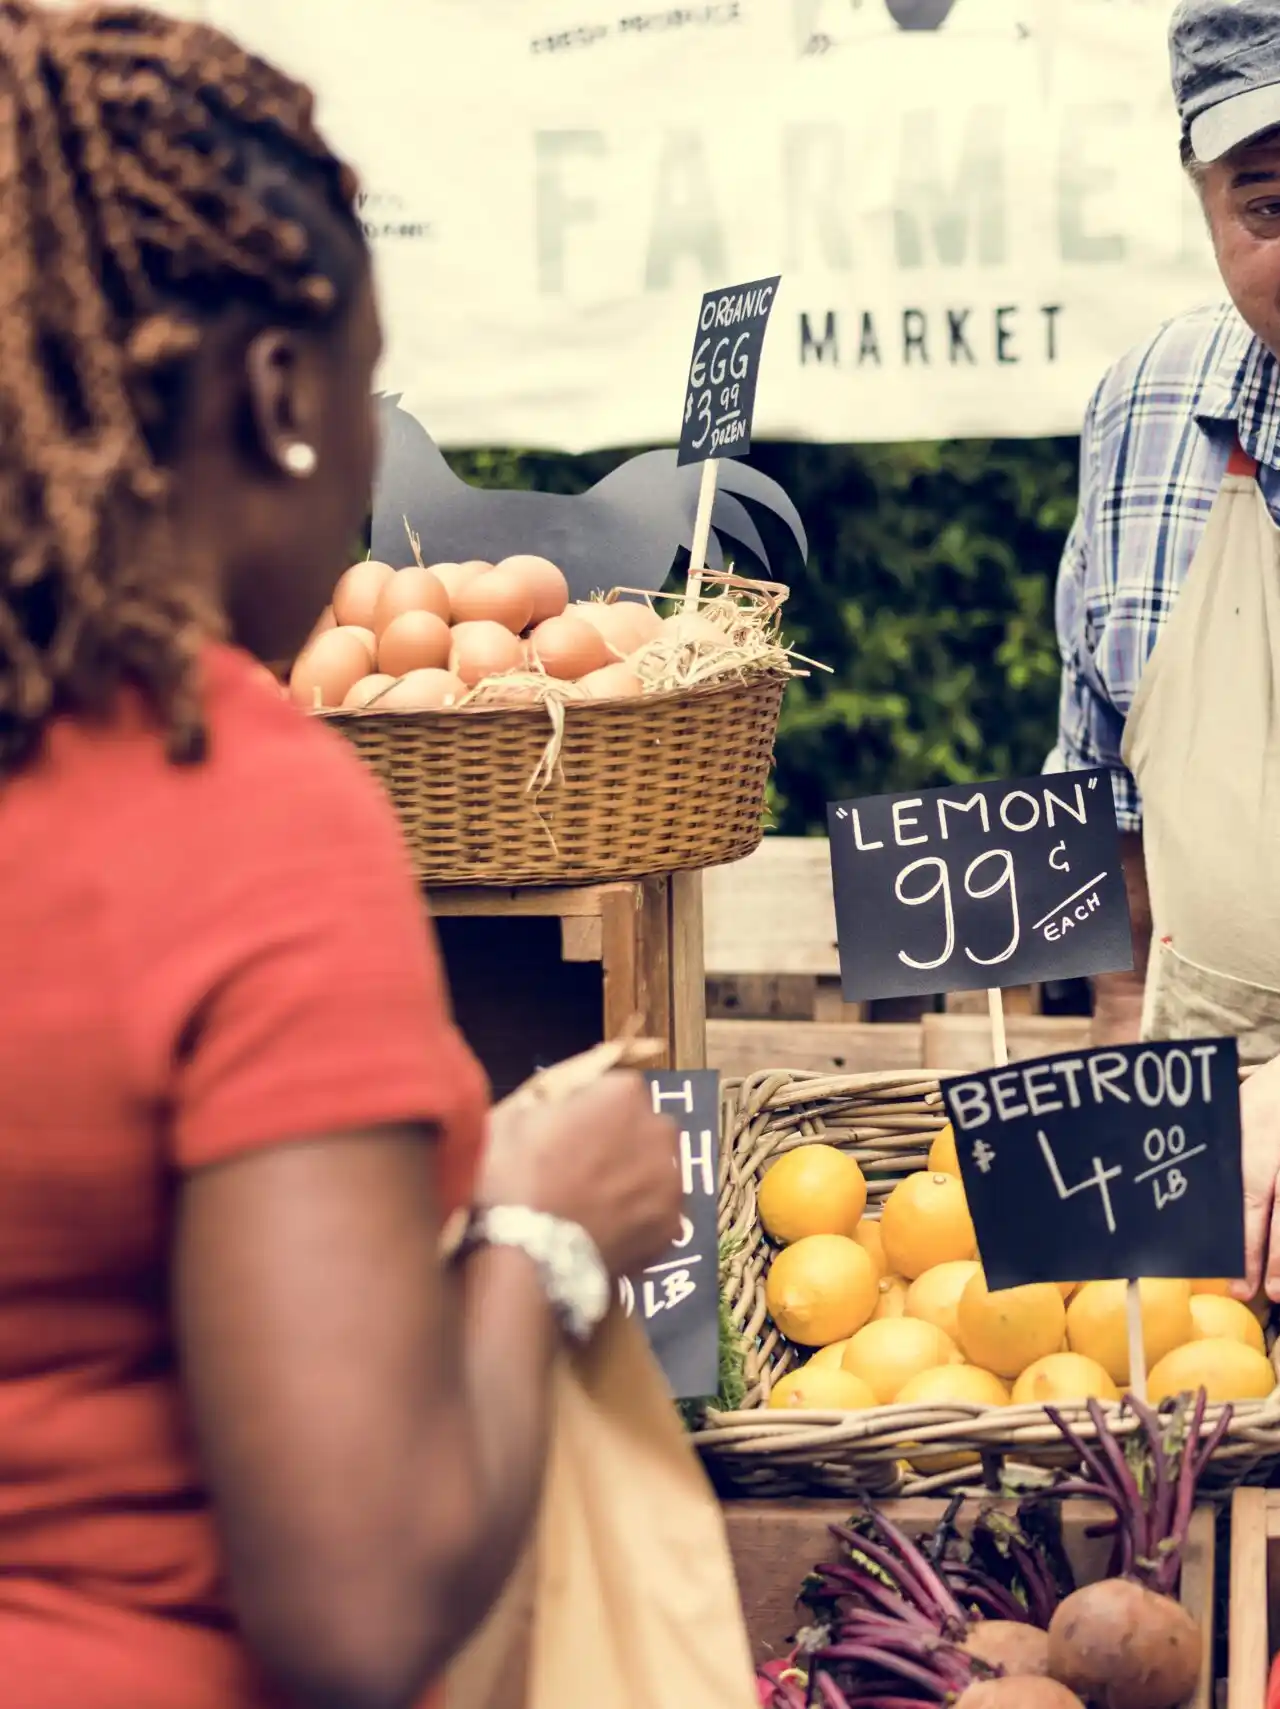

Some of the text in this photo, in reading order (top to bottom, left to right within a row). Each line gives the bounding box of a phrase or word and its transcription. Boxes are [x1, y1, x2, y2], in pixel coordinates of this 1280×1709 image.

[533, 100, 1212, 297] FARME
[701, 286, 772, 331] ORGANIC
[690, 332, 750, 388] EGG
[798, 305, 1064, 366] MARKET
[709, 419, 747, 455] DOZEN
[895, 849, 1020, 969] 99
[1044, 892, 1100, 941] EACH
[948, 1045, 1217, 1130] BEETROOT
[1153, 1168, 1187, 1210] LB
[643, 1270, 696, 1319] LB
